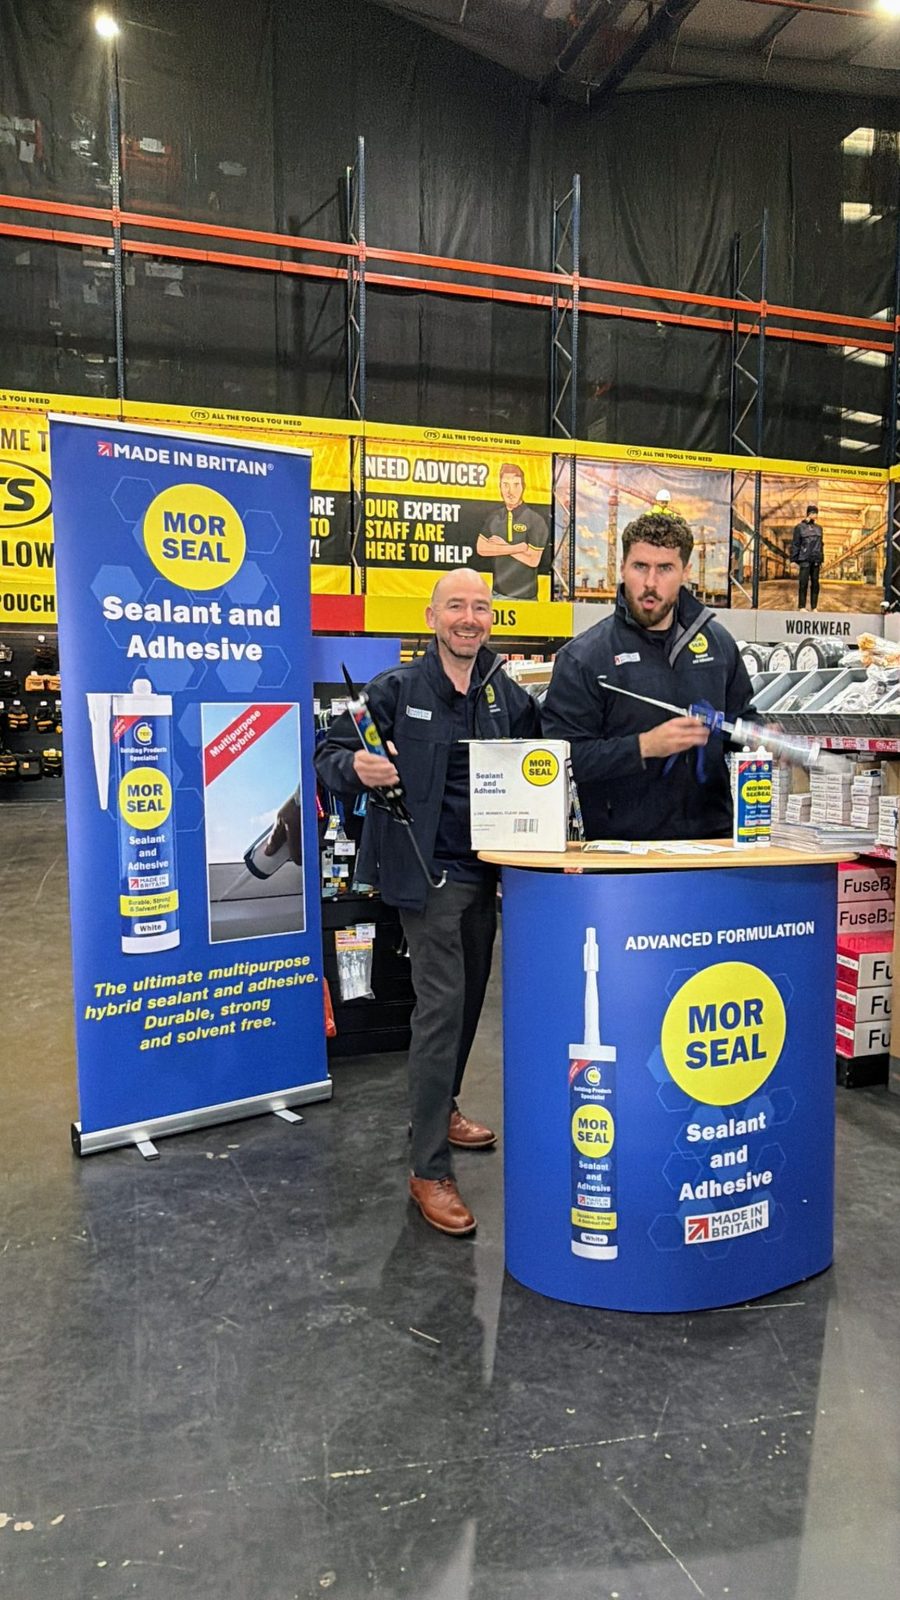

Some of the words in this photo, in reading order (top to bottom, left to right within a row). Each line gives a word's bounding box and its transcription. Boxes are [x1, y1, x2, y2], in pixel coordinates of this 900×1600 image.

[9, 395, 27, 403] YOU
[211, 412, 225, 421] ALL
[226, 414, 240, 422] THE
[241, 415, 265, 424] TOOLS
[266, 418, 283, 426] YOU
[441, 432, 454, 441] ALL
[455, 434, 467, 442] THE
[468, 435, 489, 444] TOOLS
[114, 443, 170, 465] MADE
[174, 451, 194, 467] IN
[643, 450, 654, 458] ALL
[365, 456, 409, 481] NEED
[414, 461, 489, 487] ADVICE?
[365, 497, 399, 519] OUR
[403, 501, 461, 522] EXPERT
[163, 511, 226, 537] MOR
[365, 520, 409, 541] STAFF
[414, 524, 444, 542] ARE
[162, 538, 230, 563] SEAL
[365, 540, 405, 561] HERE
[410, 543, 429, 562] TO
[434, 545, 473, 564] HELP
[0, 592, 55, 612] OUCH
[102, 595, 222, 625] Sealant
[228, 605, 281, 626] and
[785, 619, 851, 636] WORKWEAR
[127, 635, 262, 661] Adhesive
[209, 710, 261, 757] Multipurpose
[228, 728, 256, 754] Hybrid
[127, 785, 163, 797] MOR
[127, 799, 166, 812] SEAL
[129, 835, 166, 845] Sealant
[139, 849, 157, 857] and
[128, 861, 169, 871] Adhesive
[625, 931, 712, 951] ADVANCED
[717, 921, 815, 944] FORMULATION
[94, 983, 126, 998] The
[133, 971, 203, 993] ultimate
[208, 955, 310, 981] multipurpose
[85, 998, 142, 1021] hybrid
[147, 987, 208, 1010] sealant
[214, 982, 243, 998] and
[248, 971, 319, 994] adhesive.
[144, 1008, 215, 1030] Durable,
[220, 999, 271, 1017] strong
[688, 998, 764, 1034] MOR
[139, 1035, 172, 1051] and
[176, 1023, 236, 1043] solvent
[241, 1014, 276, 1033] free.
[685, 1034, 767, 1071] SEAL
[578, 1118, 608, 1131] MOR
[686, 1112, 767, 1142] Sealant
[577, 1131, 609, 1144] SEAL
[579, 1161, 609, 1171] Sealant
[710, 1145, 749, 1169] and
[577, 1182, 611, 1192] Adhesive
[679, 1170, 773, 1202] Adhesive
[711, 1209, 748, 1226] MADE
[711, 1217, 763, 1238] BRITAIN
